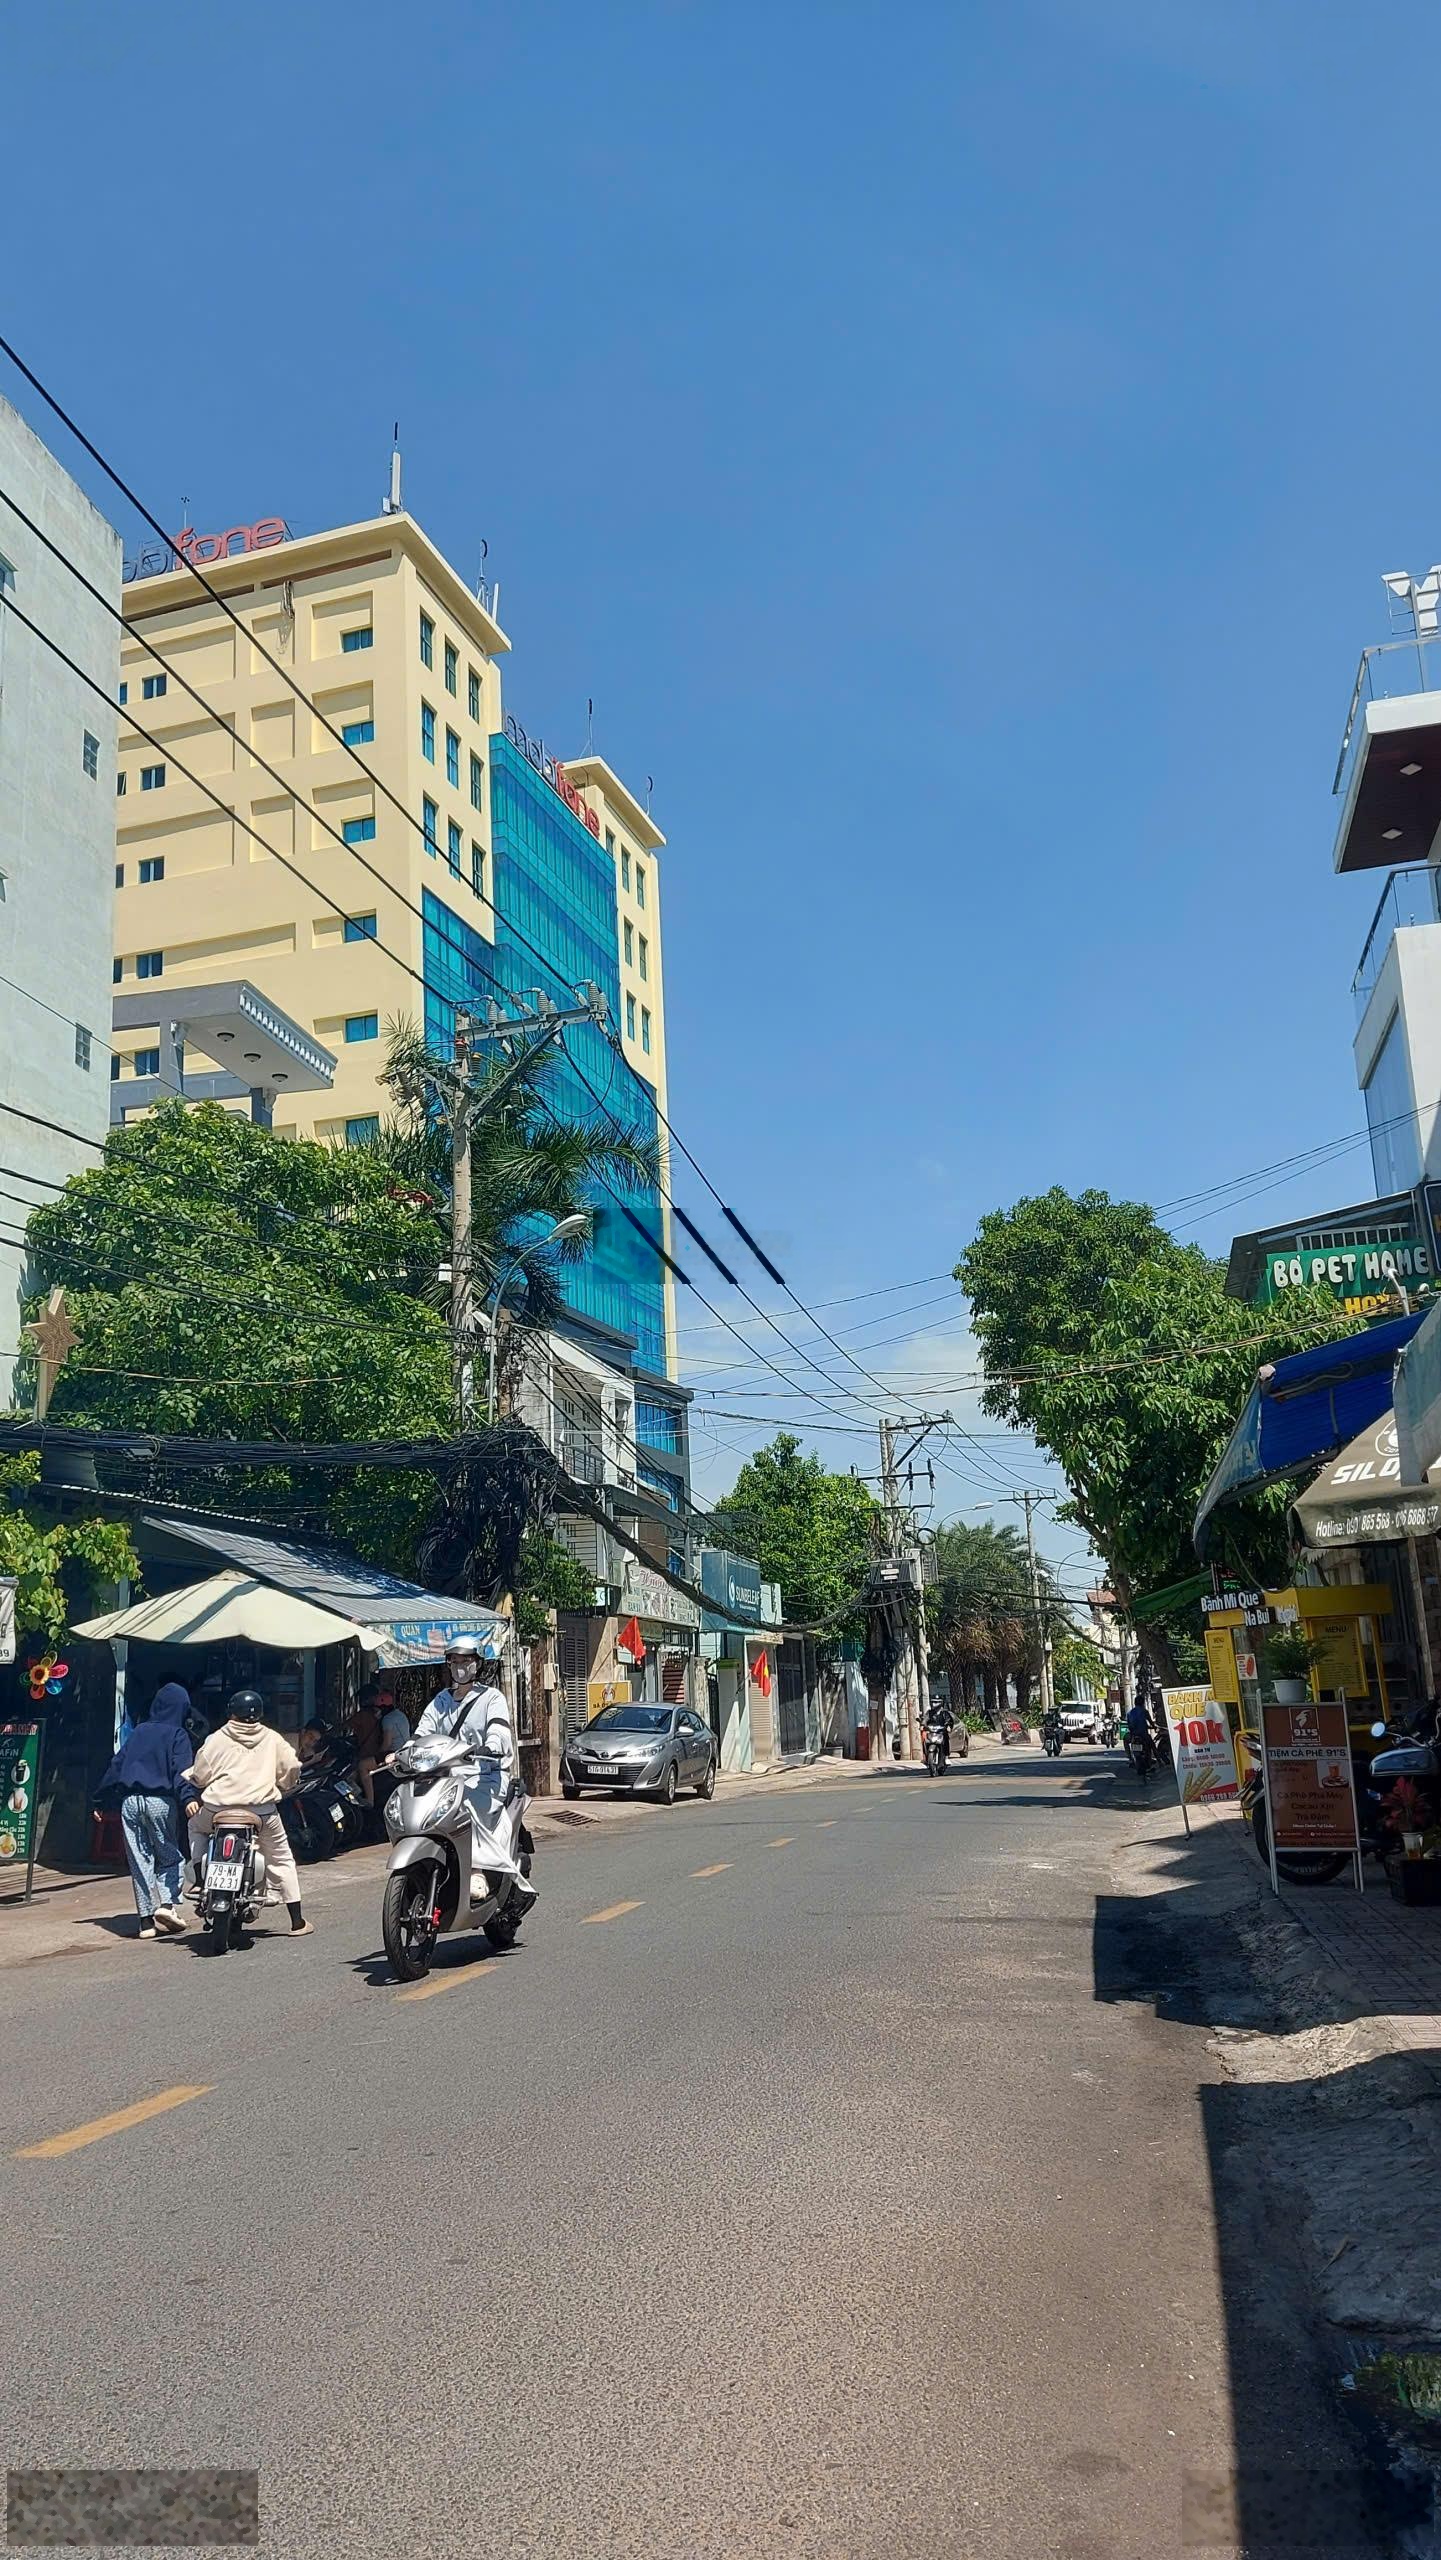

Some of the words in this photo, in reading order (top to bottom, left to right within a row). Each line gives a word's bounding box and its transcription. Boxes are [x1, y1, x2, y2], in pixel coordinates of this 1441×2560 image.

[123, 517, 285, 583] obifone
[1311, 1254, 1356, 1283] PET
[1364, 1246, 1429, 1280] HOME
[1238, 1591, 1260, 1609] Que
[1326, 1624, 1348, 1633] MENU
[1170, 1701, 1206, 1720] QUE
[1294, 1728, 1318, 1737] 91'S
